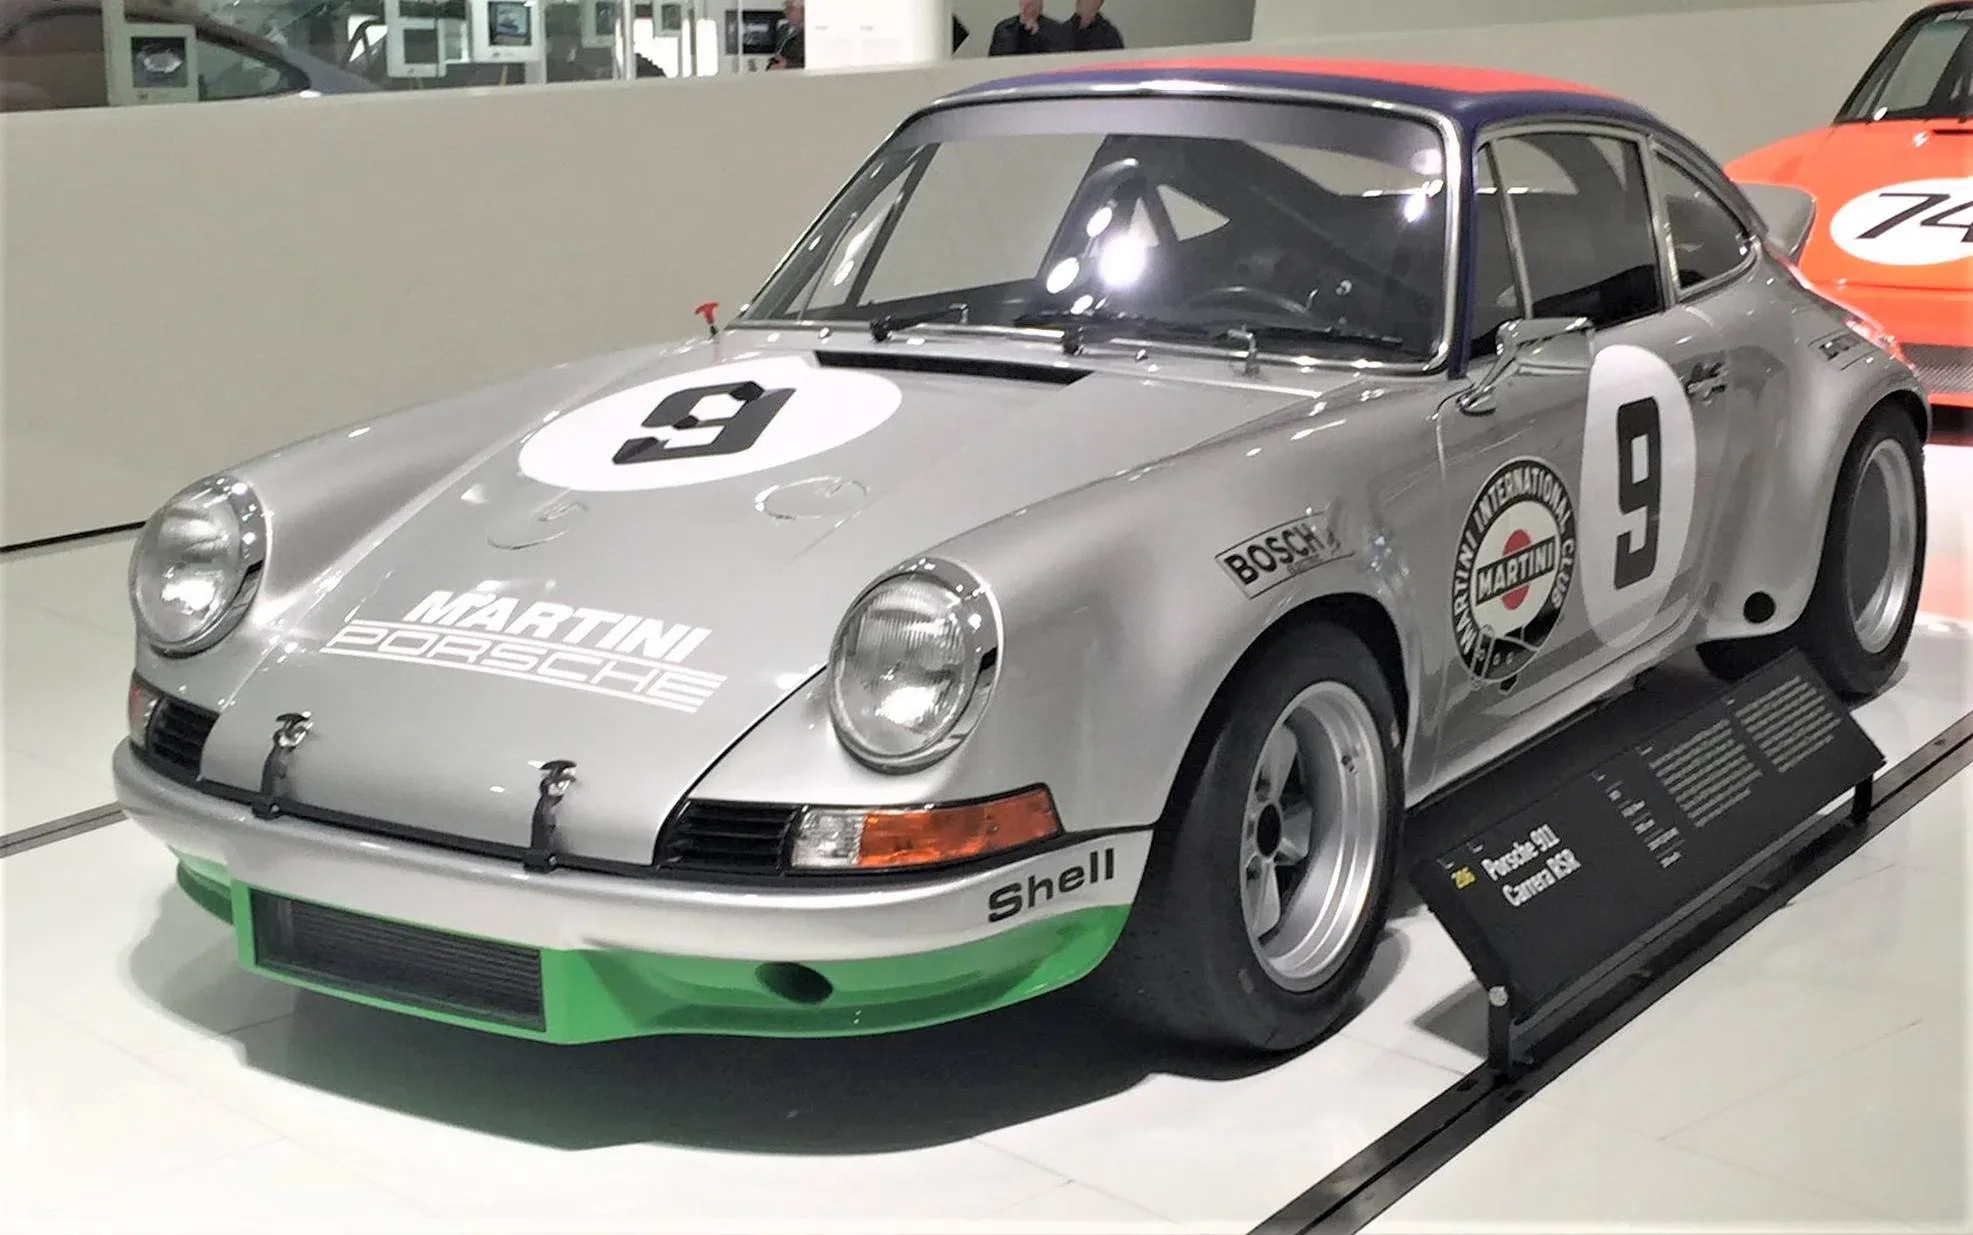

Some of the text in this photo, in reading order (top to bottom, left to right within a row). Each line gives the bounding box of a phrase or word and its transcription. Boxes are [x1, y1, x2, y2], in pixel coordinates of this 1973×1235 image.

[1854, 192, 1973, 243] 74
[612, 380, 797, 465] 9
[1614, 396, 1662, 590] 9
[1224, 522, 1325, 585] BOSCH
[1453, 466, 1575, 655] MARTINI INTERNATIONAL CLUB
[1478, 541, 1555, 602] MARTINI
[402, 590, 712, 663] MARTINI
[325, 626, 721, 708] PORSCHE
[988, 848, 1114, 922] Shell
[1481, 824, 1560, 881] Porsche 911
[1502, 849, 1581, 907] Carrera RSR
